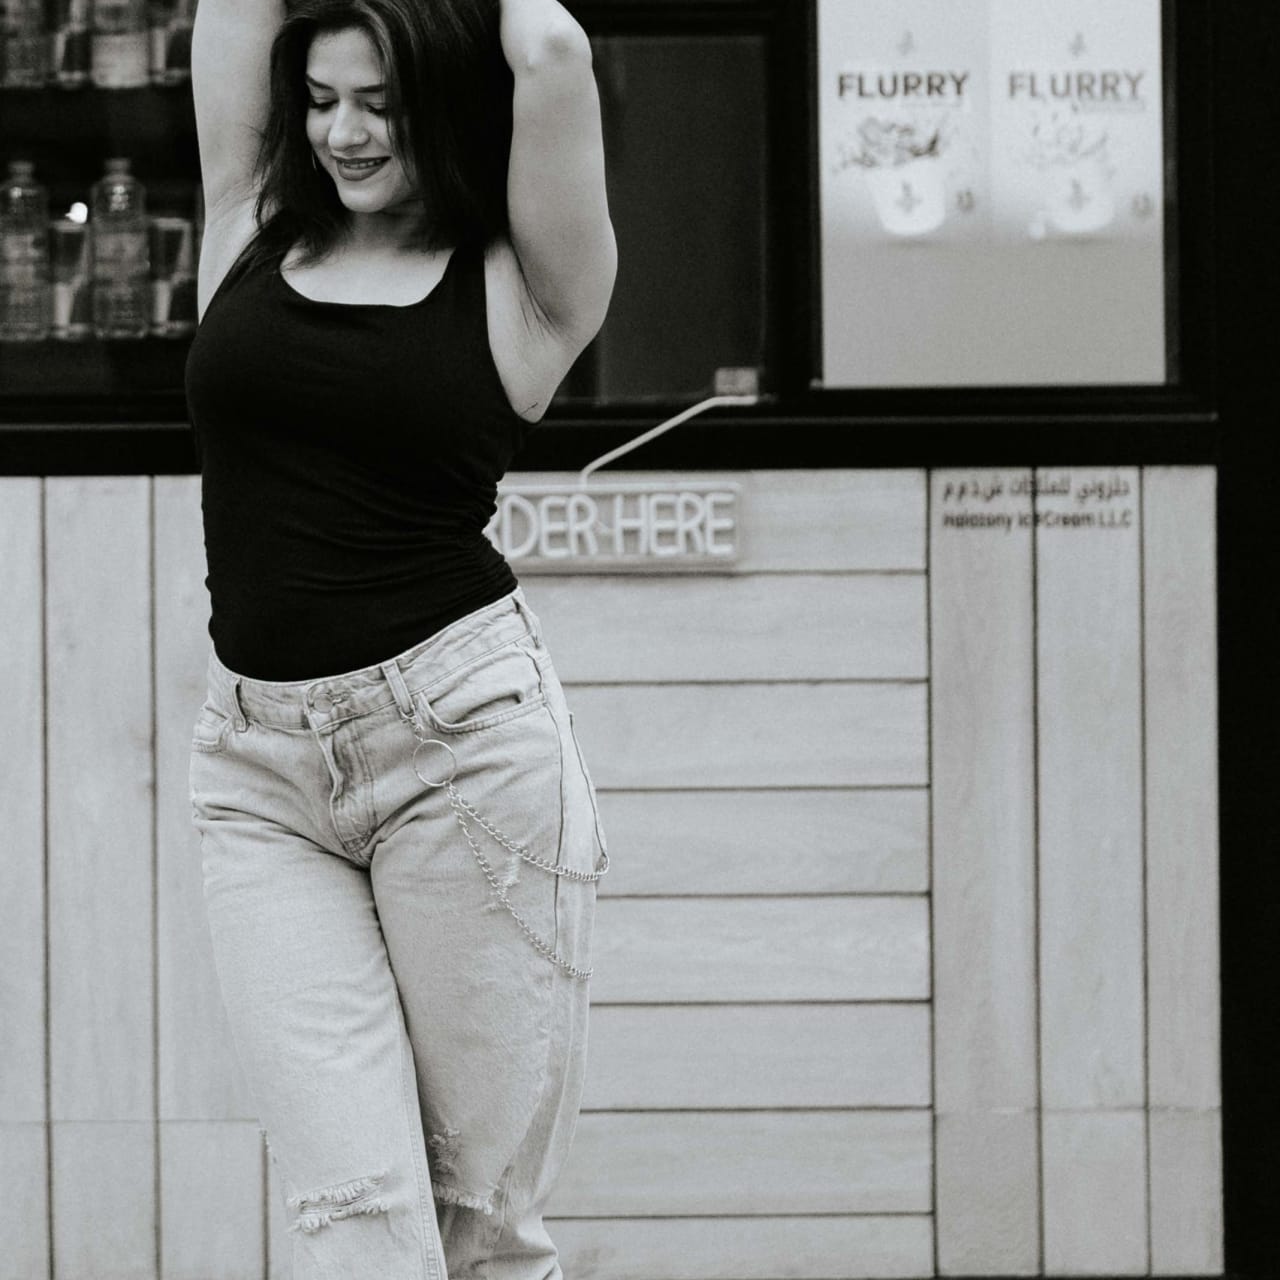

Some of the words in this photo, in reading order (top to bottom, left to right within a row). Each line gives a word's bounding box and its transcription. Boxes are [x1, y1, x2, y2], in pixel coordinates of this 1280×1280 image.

[838, 73, 970, 98] FLURRY
[1008, 73, 1145, 99] FLURRY
[613, 492, 735, 557] HERE
